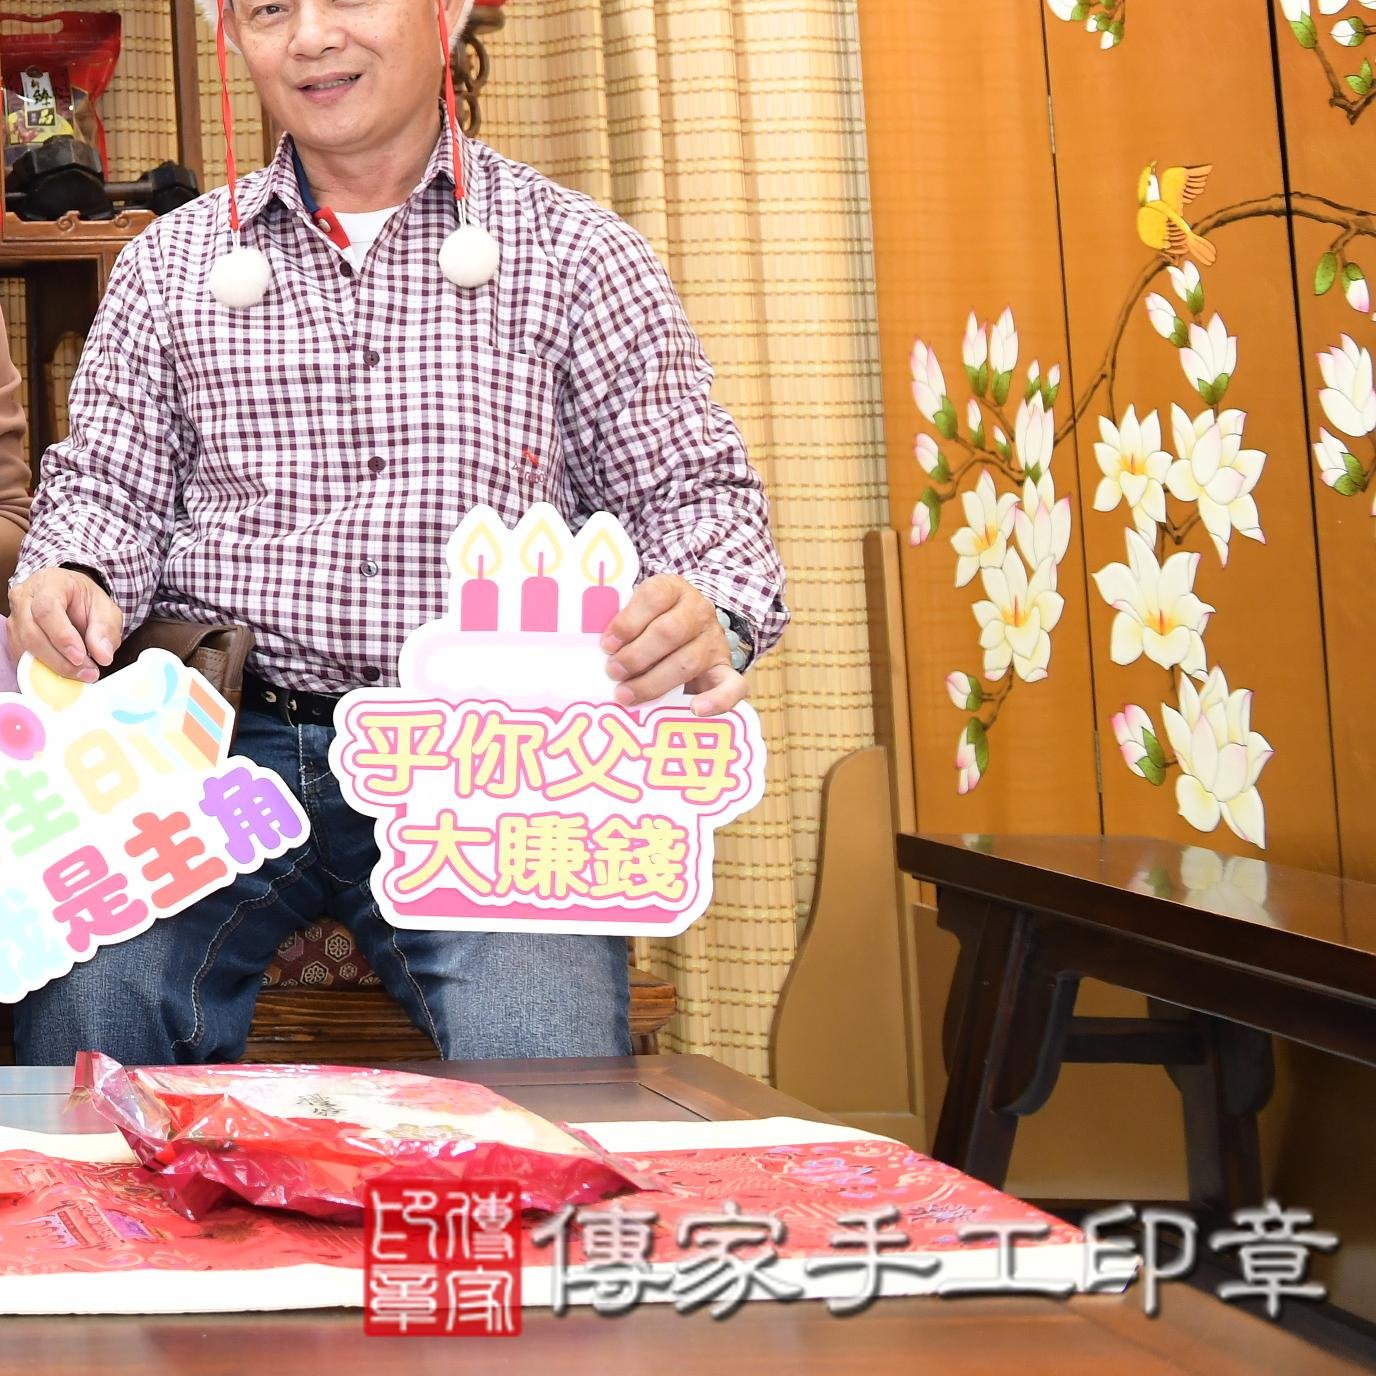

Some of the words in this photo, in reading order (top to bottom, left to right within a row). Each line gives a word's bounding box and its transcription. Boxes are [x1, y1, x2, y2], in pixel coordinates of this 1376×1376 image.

[354, 709, 739, 803] 乎你父母
[396, 810, 689, 901] 大賺錢
